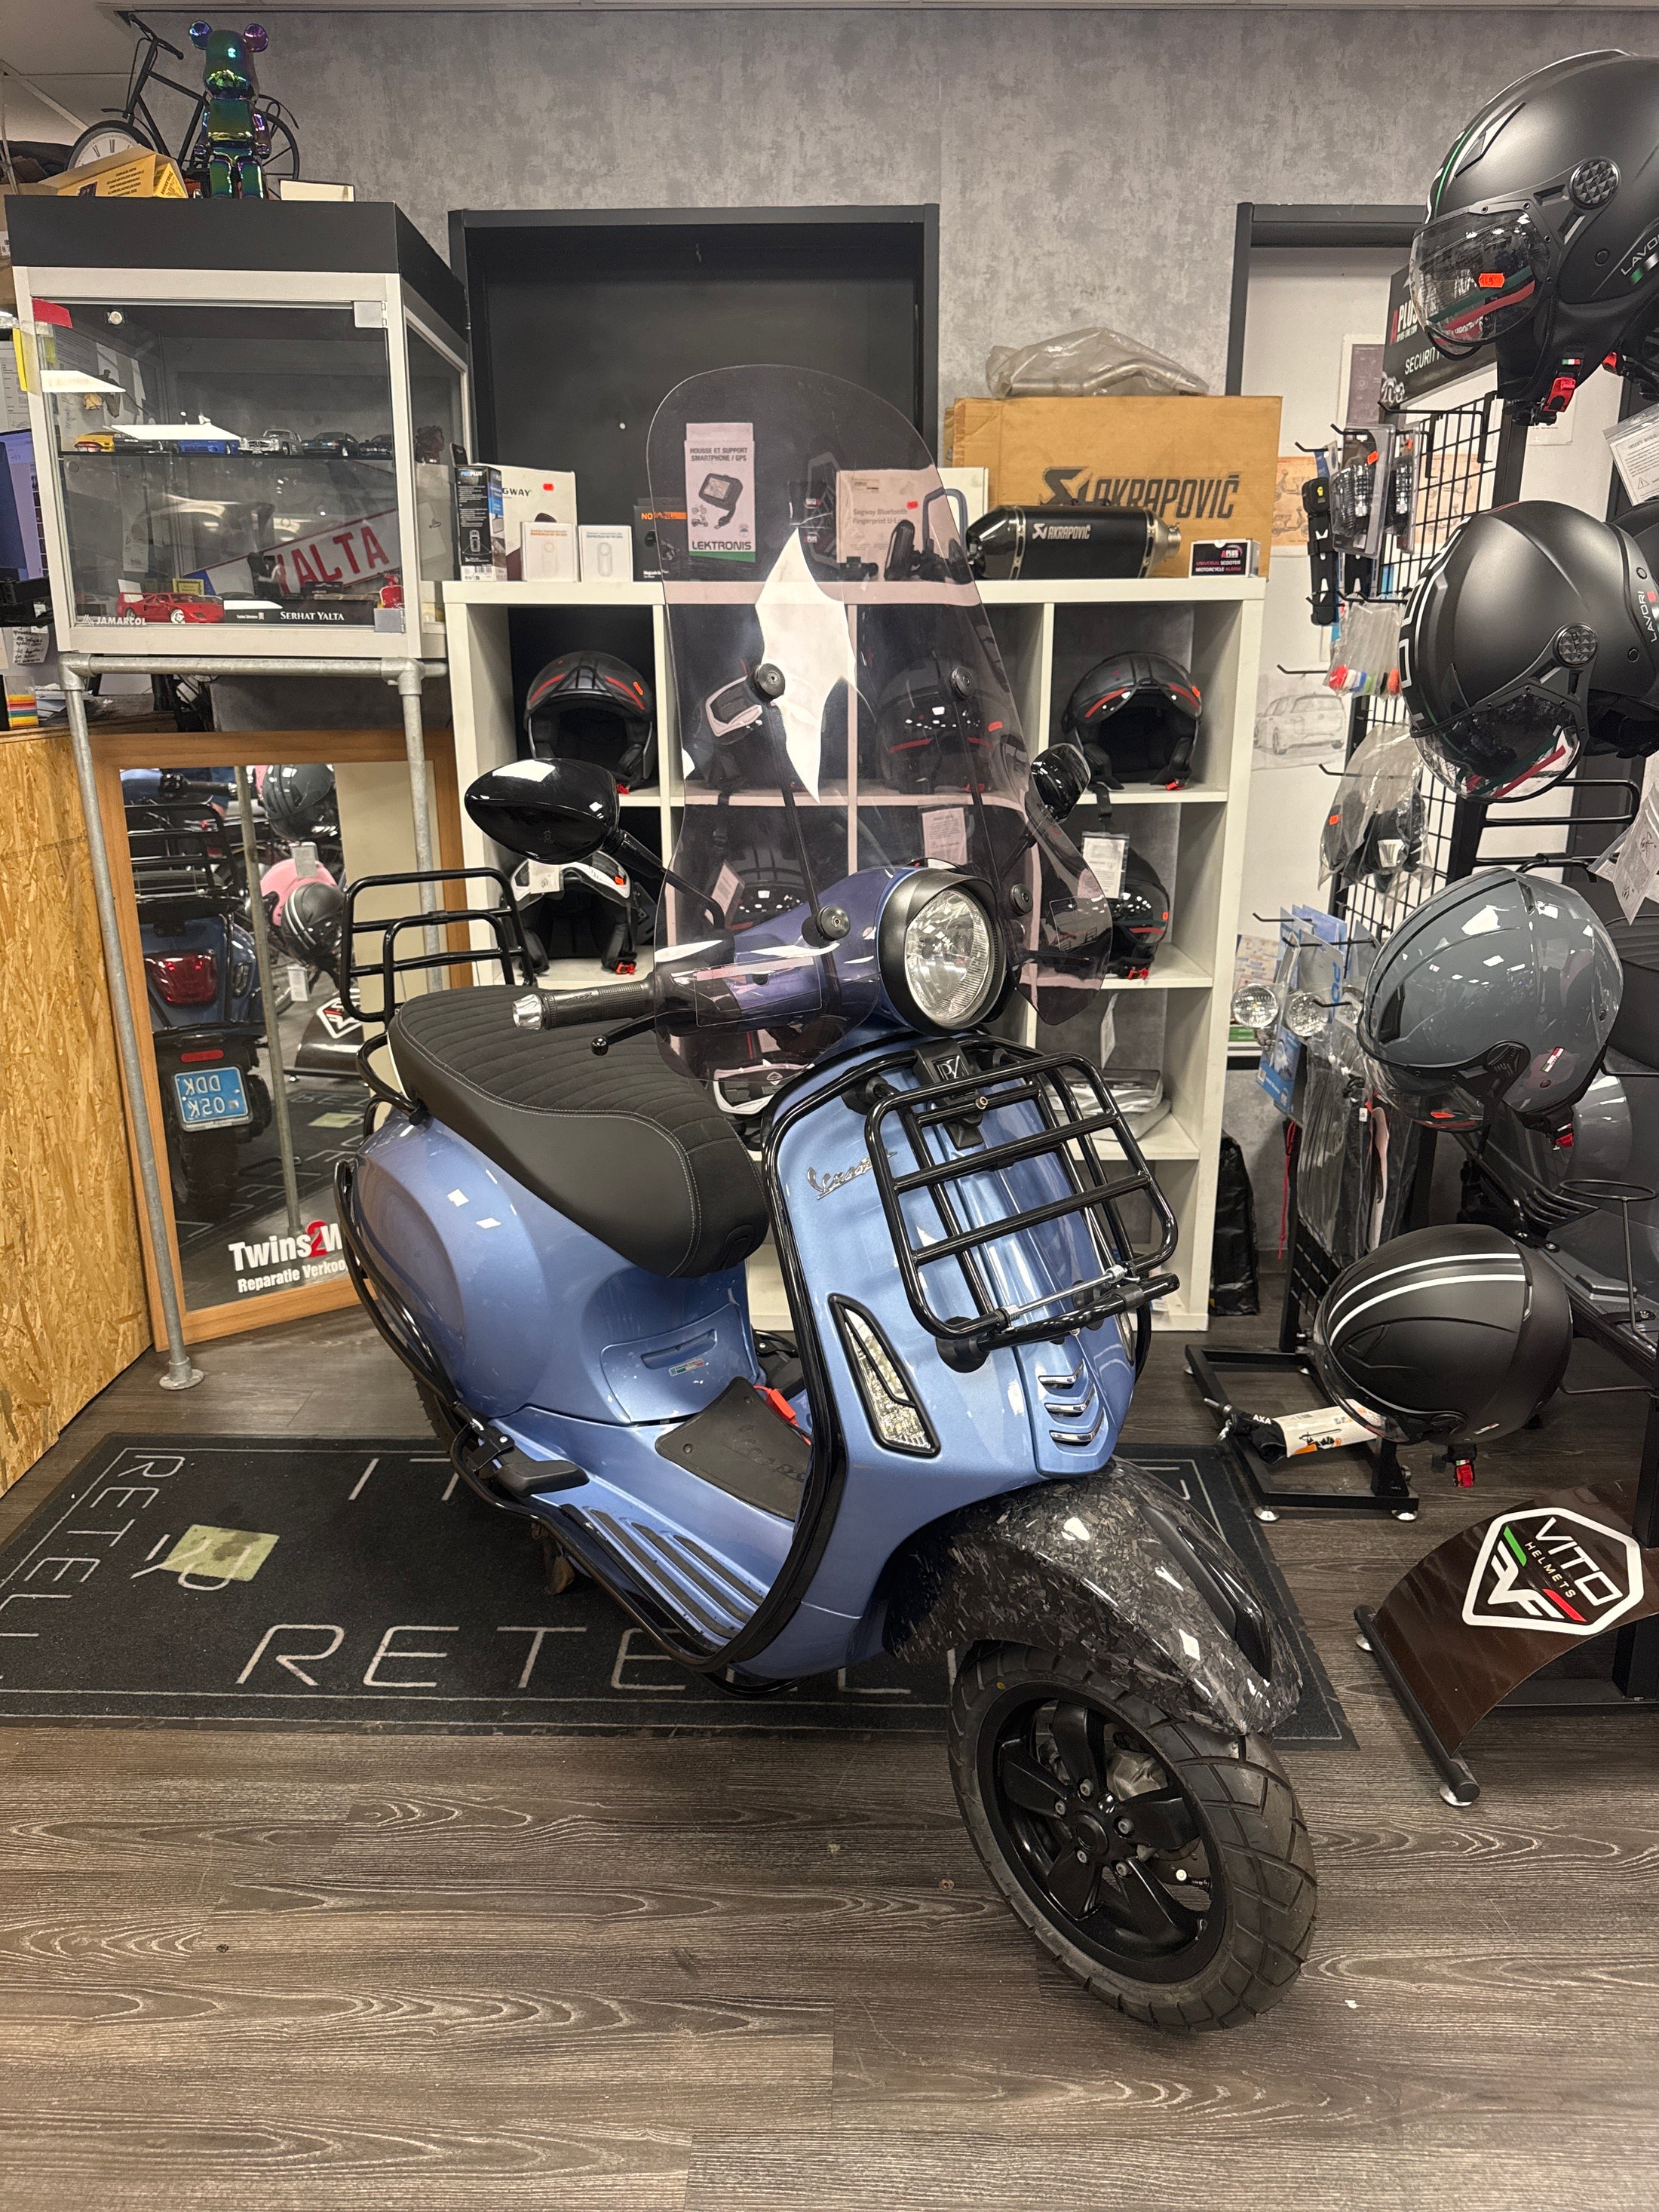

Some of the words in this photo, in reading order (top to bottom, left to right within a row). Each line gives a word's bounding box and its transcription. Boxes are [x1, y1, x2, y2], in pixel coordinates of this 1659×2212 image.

[692, 541, 752, 551] LEKTRONIS
[280, 611, 315, 621] SERHAT
[316, 612, 345, 621] YALTA
[1637, 591, 1657, 643] LAVORI
[807, 1149, 898, 1201] Vesp
[237, 1268, 301, 1293] Reparatie
[302, 1259, 349, 1279] Verkoo
[1253, 1414, 1272, 1425] AXA
[1524, 1541, 1577, 1599] HELMETS
[1535, 1516, 1624, 1606] VITO
